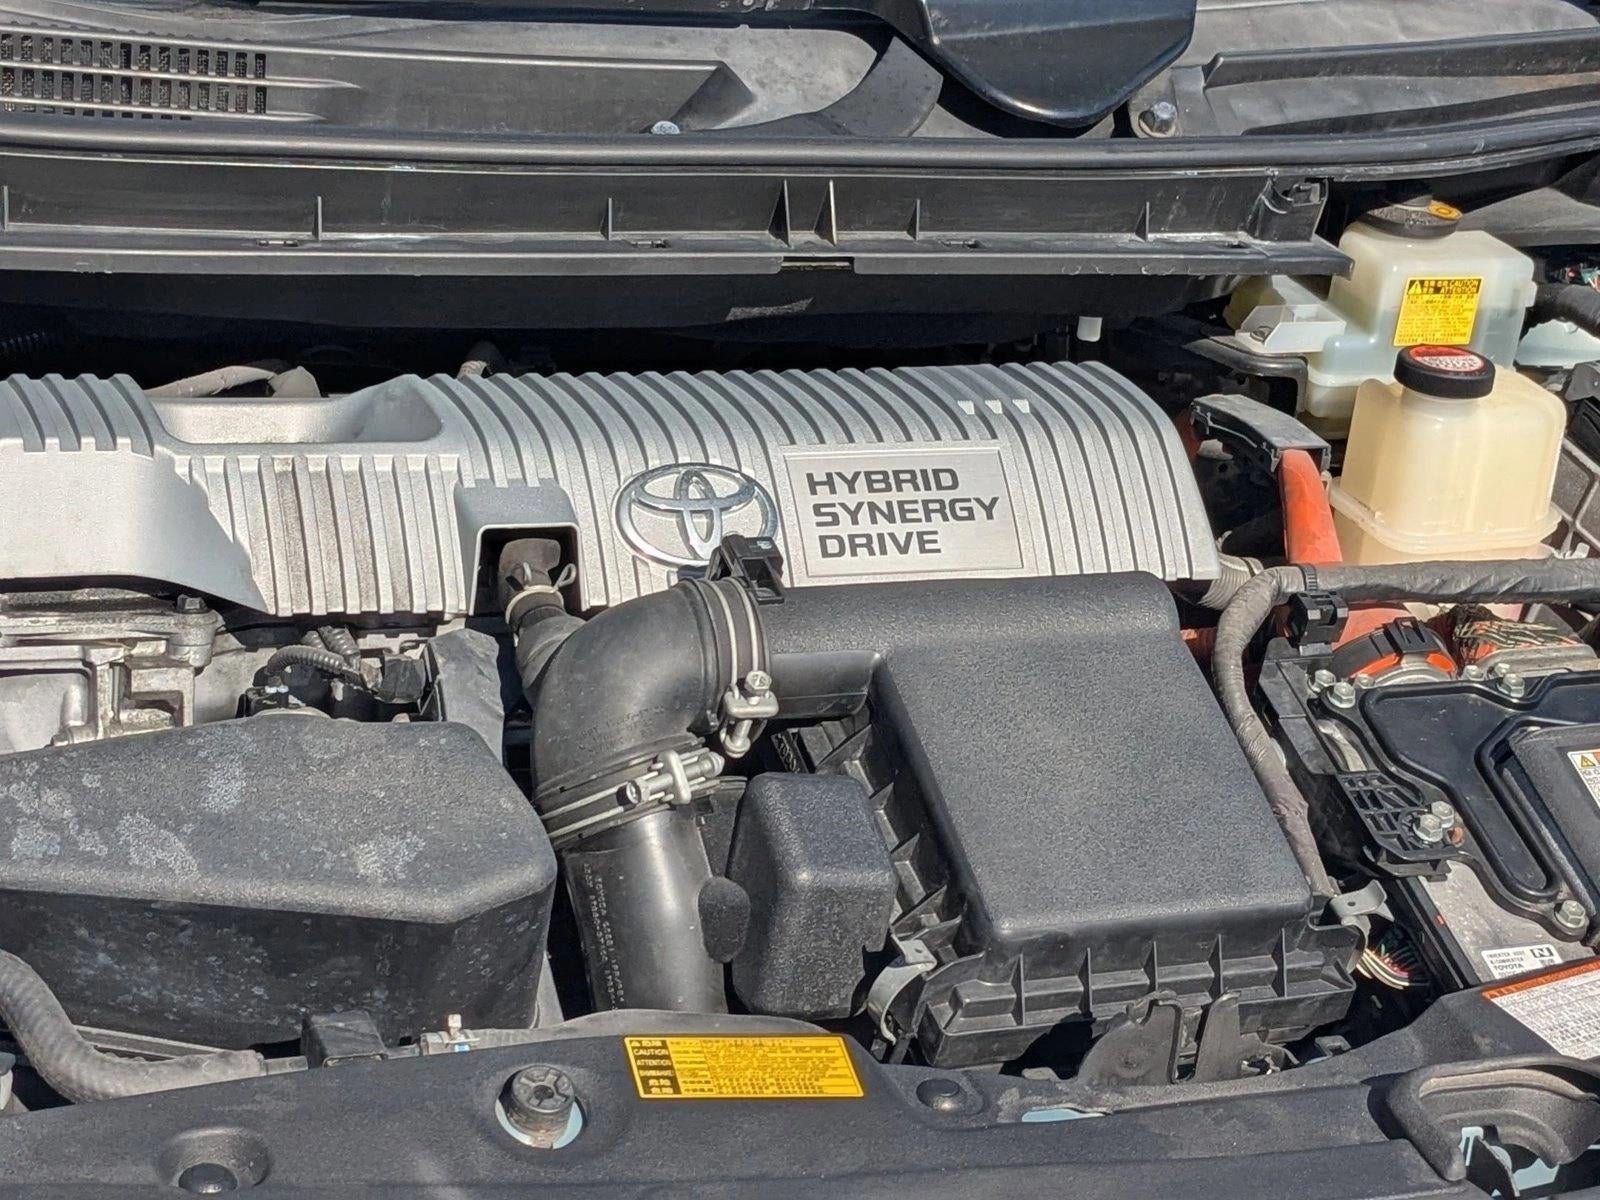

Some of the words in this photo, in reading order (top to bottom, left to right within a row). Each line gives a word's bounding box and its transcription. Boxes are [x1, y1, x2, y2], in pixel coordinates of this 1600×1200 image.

[805, 468, 959, 495] HYBRID
[813, 497, 999, 526] SYNERGY
[818, 530, 942, 558] DRIVE
[1494, 963, 1524, 971] TOYOTA
[633, 1048, 669, 1056] CAUTION
